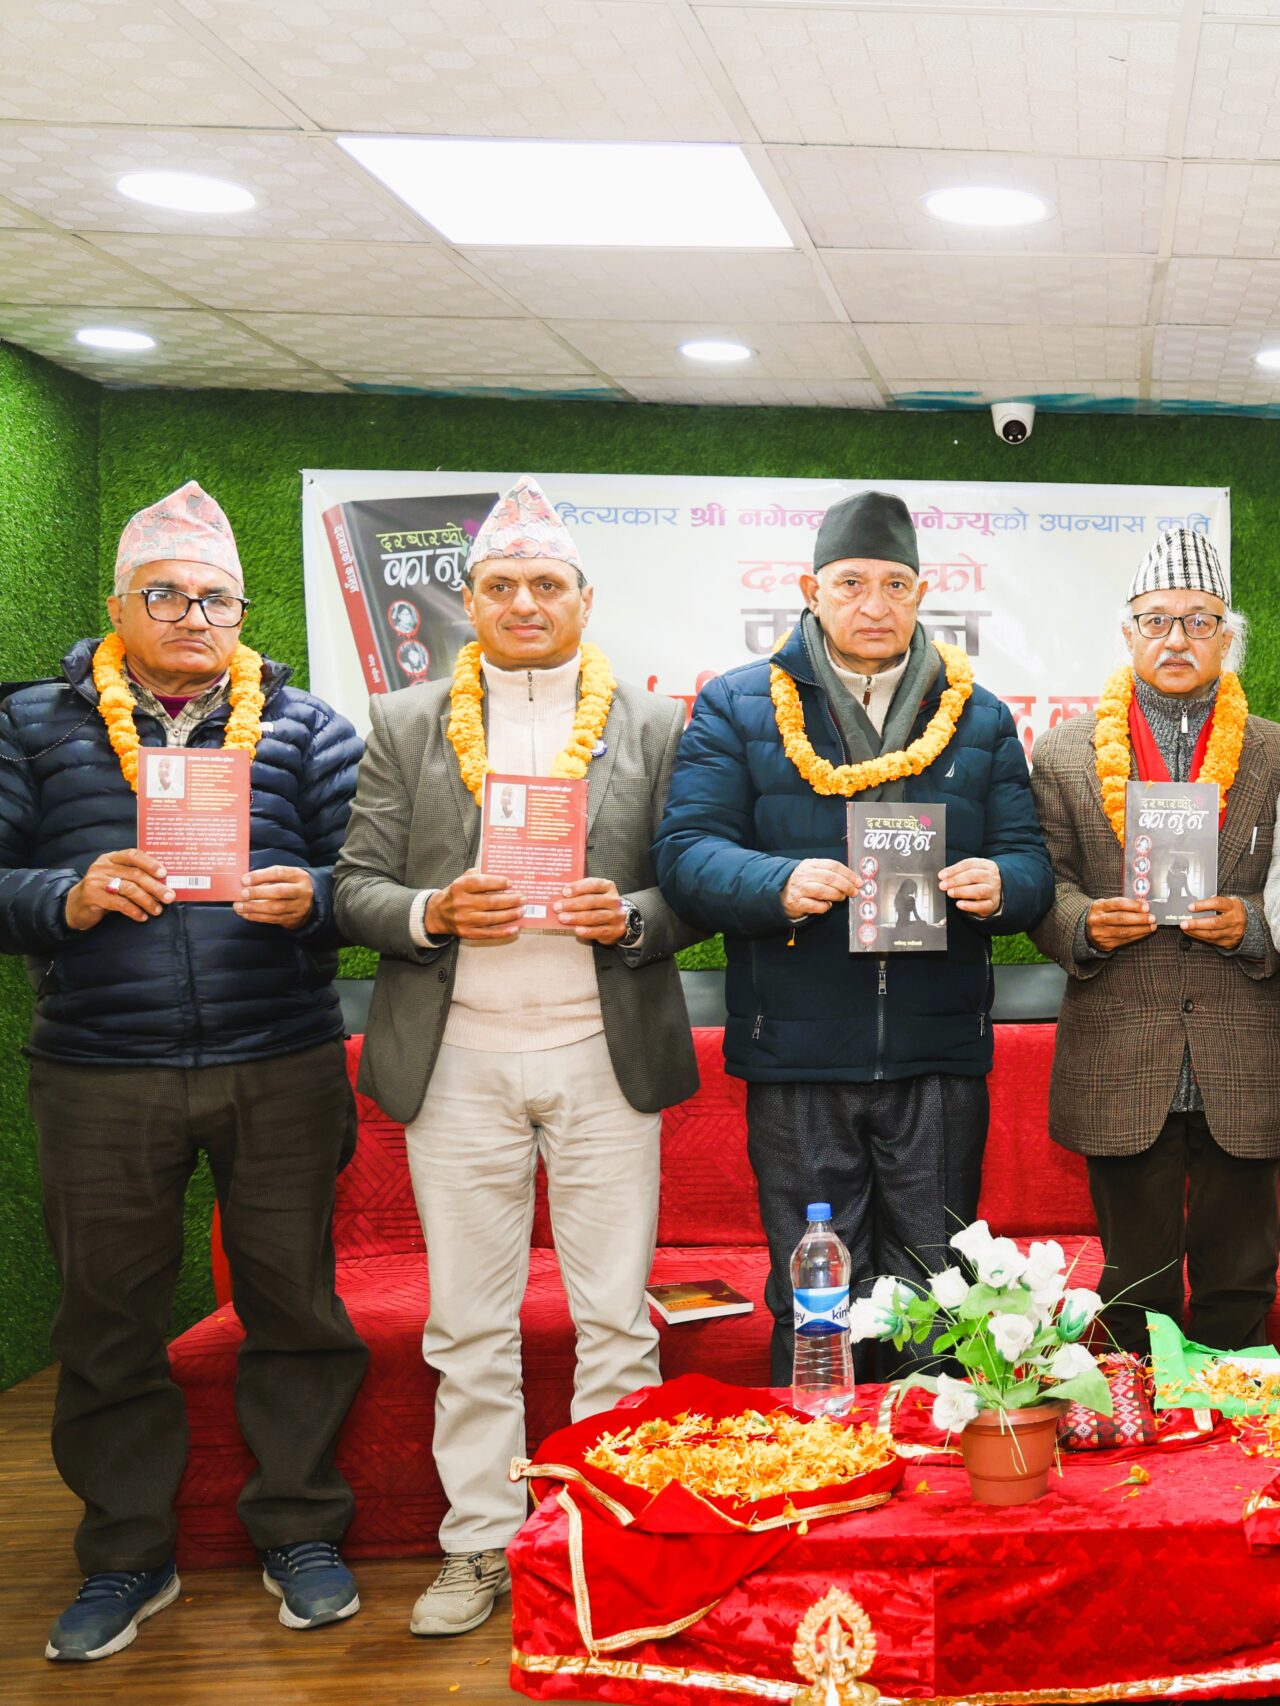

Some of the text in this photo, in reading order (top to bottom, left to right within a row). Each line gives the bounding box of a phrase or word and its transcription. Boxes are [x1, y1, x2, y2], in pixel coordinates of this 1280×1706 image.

[554, 501, 680, 526] हित्यकार
[690, 503, 728, 528] श्री
[1039, 513, 1146, 533] उपन्यास
[1155, 512, 1212, 534] कति
[376, 522, 465, 552] दरबारको
[381, 546, 466, 591] कानु
[1138, 809, 1209, 835] कानुन
[863, 829, 937, 857] कानुन
[832, 1306, 849, 1320] kin
